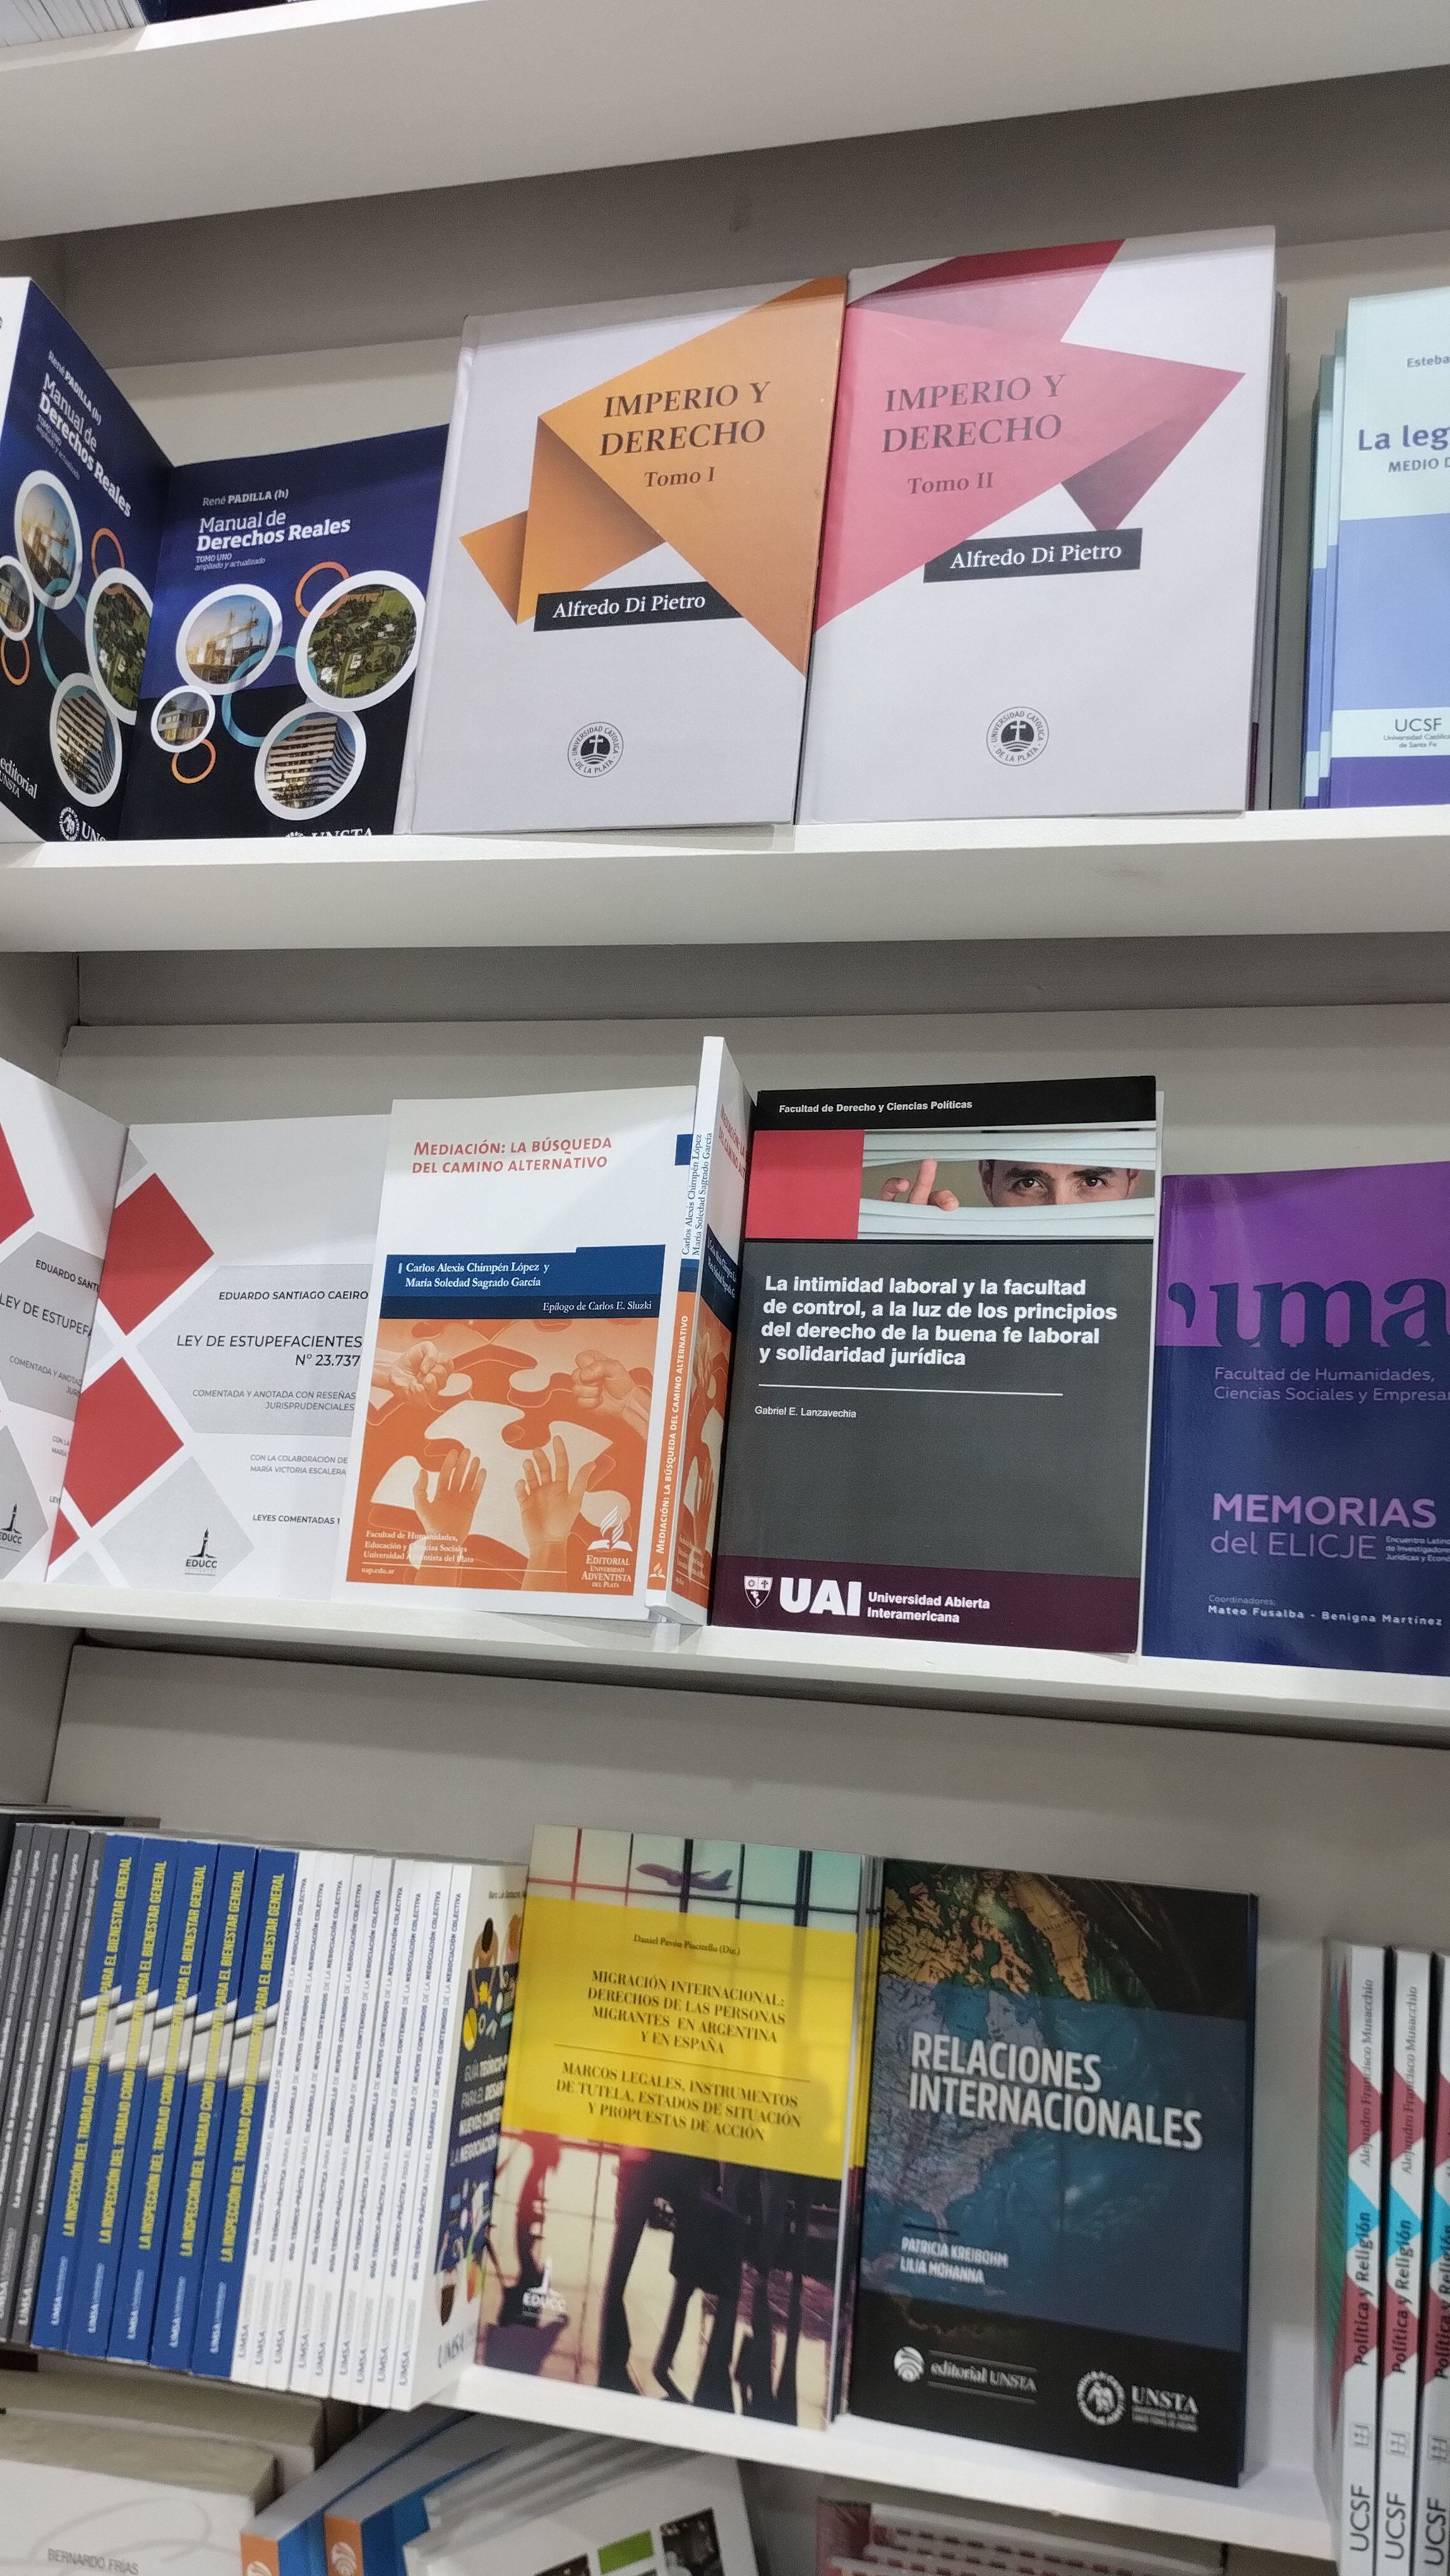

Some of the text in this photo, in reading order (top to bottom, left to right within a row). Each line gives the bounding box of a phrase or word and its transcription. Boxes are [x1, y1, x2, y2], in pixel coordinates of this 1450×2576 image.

[602, 380, 772, 419] IMPERIO Y
[884, 373, 1067, 413] IMPERIO Y
[42, 372, 97, 453] Manual de
[598, 418, 766, 456] DERECHO
[881, 413, 1062, 454] DERECHO
[1358, 424, 1450, 451] La leg
[39, 391, 132, 518] Derechos Reales
[1388, 458, 1439, 474] MEDIO
[644, 466, 717, 487] Tomo I
[908, 472, 995, 494] Tomo II
[202, 488, 289, 506] René PADILLA (h)
[198, 510, 286, 534] Manual de
[196, 518, 351, 552] Derechos Reales
[949, 544, 1122, 569] Alfredo Di Pietro
[552, 593, 706, 619] Alfredo Di Pietro
[1394, 717, 1442, 732] UCSF
[779, 1100, 973, 1113] Facultad de Derecho y Ciencias Políticas
[510, 1142, 527, 1154] LA
[531, 1136, 613, 1155] BÚSQUEDA
[412, 1156, 608, 1174] DEL CAMINO ALTERNATIVO
[405, 1261, 551, 1275] Carlos Alexis Chimpén López y
[404, 1277, 541, 1289] María Soledad Sagrado García
[765, 1275, 1086, 1298] La intimidad laboral y la facultad
[219, 1291, 368, 1301] EDUARDO SANTIAGO CAEIRO
[542, 1301, 652, 1313] Epílogo de Carlos E. Sluzki
[763, 1299, 1118, 1323] de control, a la luz de los principios
[176, 1335, 363, 1348] LEY DE ESTUPEFACIENTES
[761, 1321, 1099, 1344] del derecho de la buena fe laboral
[315, 1354, 361, 1367] 23.737
[759, 1345, 966, 1368] y solidaridad jurídica
[1214, 1367, 1435, 1383] Facultad de Humanidades,
[193, 1389, 245, 1398] COMENTADA
[253, 1390, 294, 1398] ANOTADA
[296, 1391, 314, 1399] CON
[316, 1389, 357, 1400] RESEÑAS
[1214, 1386, 1280, 1400] Ciencias
[1285, 1386, 1353, 1402] Sociales
[1358, 1391, 1368, 1404] y
[265, 1402, 356, 1412] JURISPRUDENCIALES
[755, 1406, 786, 1416] Gabriel
[789, 1407, 798, 1416] E.
[250, 1464, 347, 1476] MARÍA VICTORIA ESCALERA
[253, 1514, 277, 1522] LEYES
[279, 1515, 335, 1525] COMENTADAS
[1213, 1493, 1437, 1529] MEMORIAS
[1211, 1530, 1258, 1554] del
[1269, 1532, 1377, 1559] ELICJE
[185, 1559, 218, 1569] EDUCC
[779, 1577, 990, 1616] UAI Universidad Abierta
[867, 1607, 960, 1624] Interamericana
[1207, 1605, 1247, 1616] Mateo
[1252, 1607, 1305, 1619] Fusalba
[1321, 1611, 1376, 1624] Benigna
[106, 1857, 131, 1953] BIENESTAR GENERAL
[452, 1893, 462, 1932] COLECTIVA
[591, 1970, 785, 2008] MIGRACIÓN INTERNACIONAL:
[587, 1987, 786, 2026] DERECHOS DE LAS PERSONAS
[591, 2005, 777, 2044] MIGRANTES EN ARGENTINA
[640, 2030, 725, 2054] Y EN ESPAÑA
[911, 2030, 1103, 2094] RELACIONES
[909, 2071, 1203, 2152] INTERNACIONALES
[901, 2236, 1010, 2269] PATRICIA KREIBOHM
[900, 2256, 986, 2286] LILIA MOHANNA
[1358, 2286, 1374, 2297] y
[930, 2360, 1038, 2394] editorial UNSTA
[1130, 2384, 1199, 2415] UNSTA
[1349, 2483, 1371, 2552] UCSF
